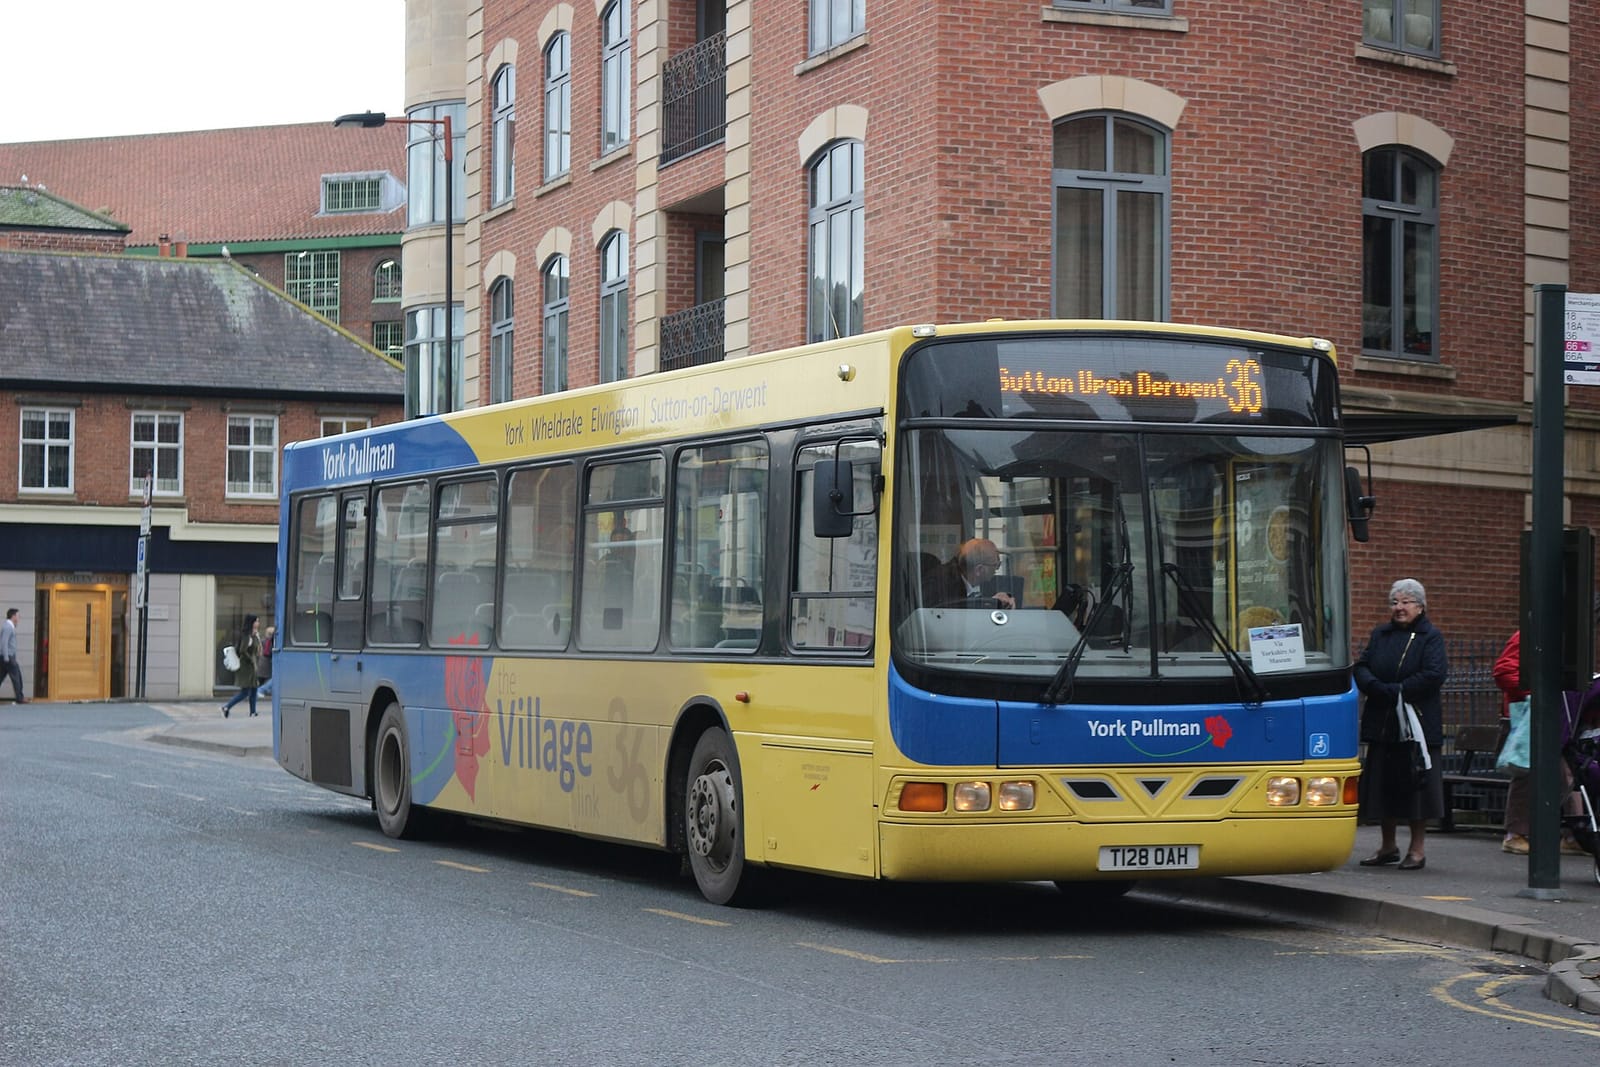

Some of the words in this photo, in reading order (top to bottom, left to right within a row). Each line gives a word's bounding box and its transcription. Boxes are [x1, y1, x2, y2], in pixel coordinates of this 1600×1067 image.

[1566, 312, 1576, 321] 18
[1566, 322, 1583, 331] 18A
[1566, 331, 1577, 340] 36
[1566, 342, 1577, 350] 66
[1566, 352, 1583, 360] 66A
[1000, 367, 1074, 393] Sutton
[1137, 372, 1229, 398] Derwent
[1225, 359, 1262, 413] 36
[504, 422, 525, 446] York
[531, 409, 584, 441] Wheldrake
[591, 402, 640, 436] Elvington
[650, 379, 768, 424] Sutton-on-Derwent
[322, 443, 346, 480] York
[348, 437, 395, 477] Pullman
[497, 667, 517, 695] the
[1087, 719, 1127, 737] York
[1131, 719, 1200, 737] Pullman
[497, 696, 593, 793] Village
[607, 696, 650, 824] 36
[576, 784, 600, 818] link
[1110, 848, 1149, 867] T128
[1154, 847, 1188, 866] OAH
